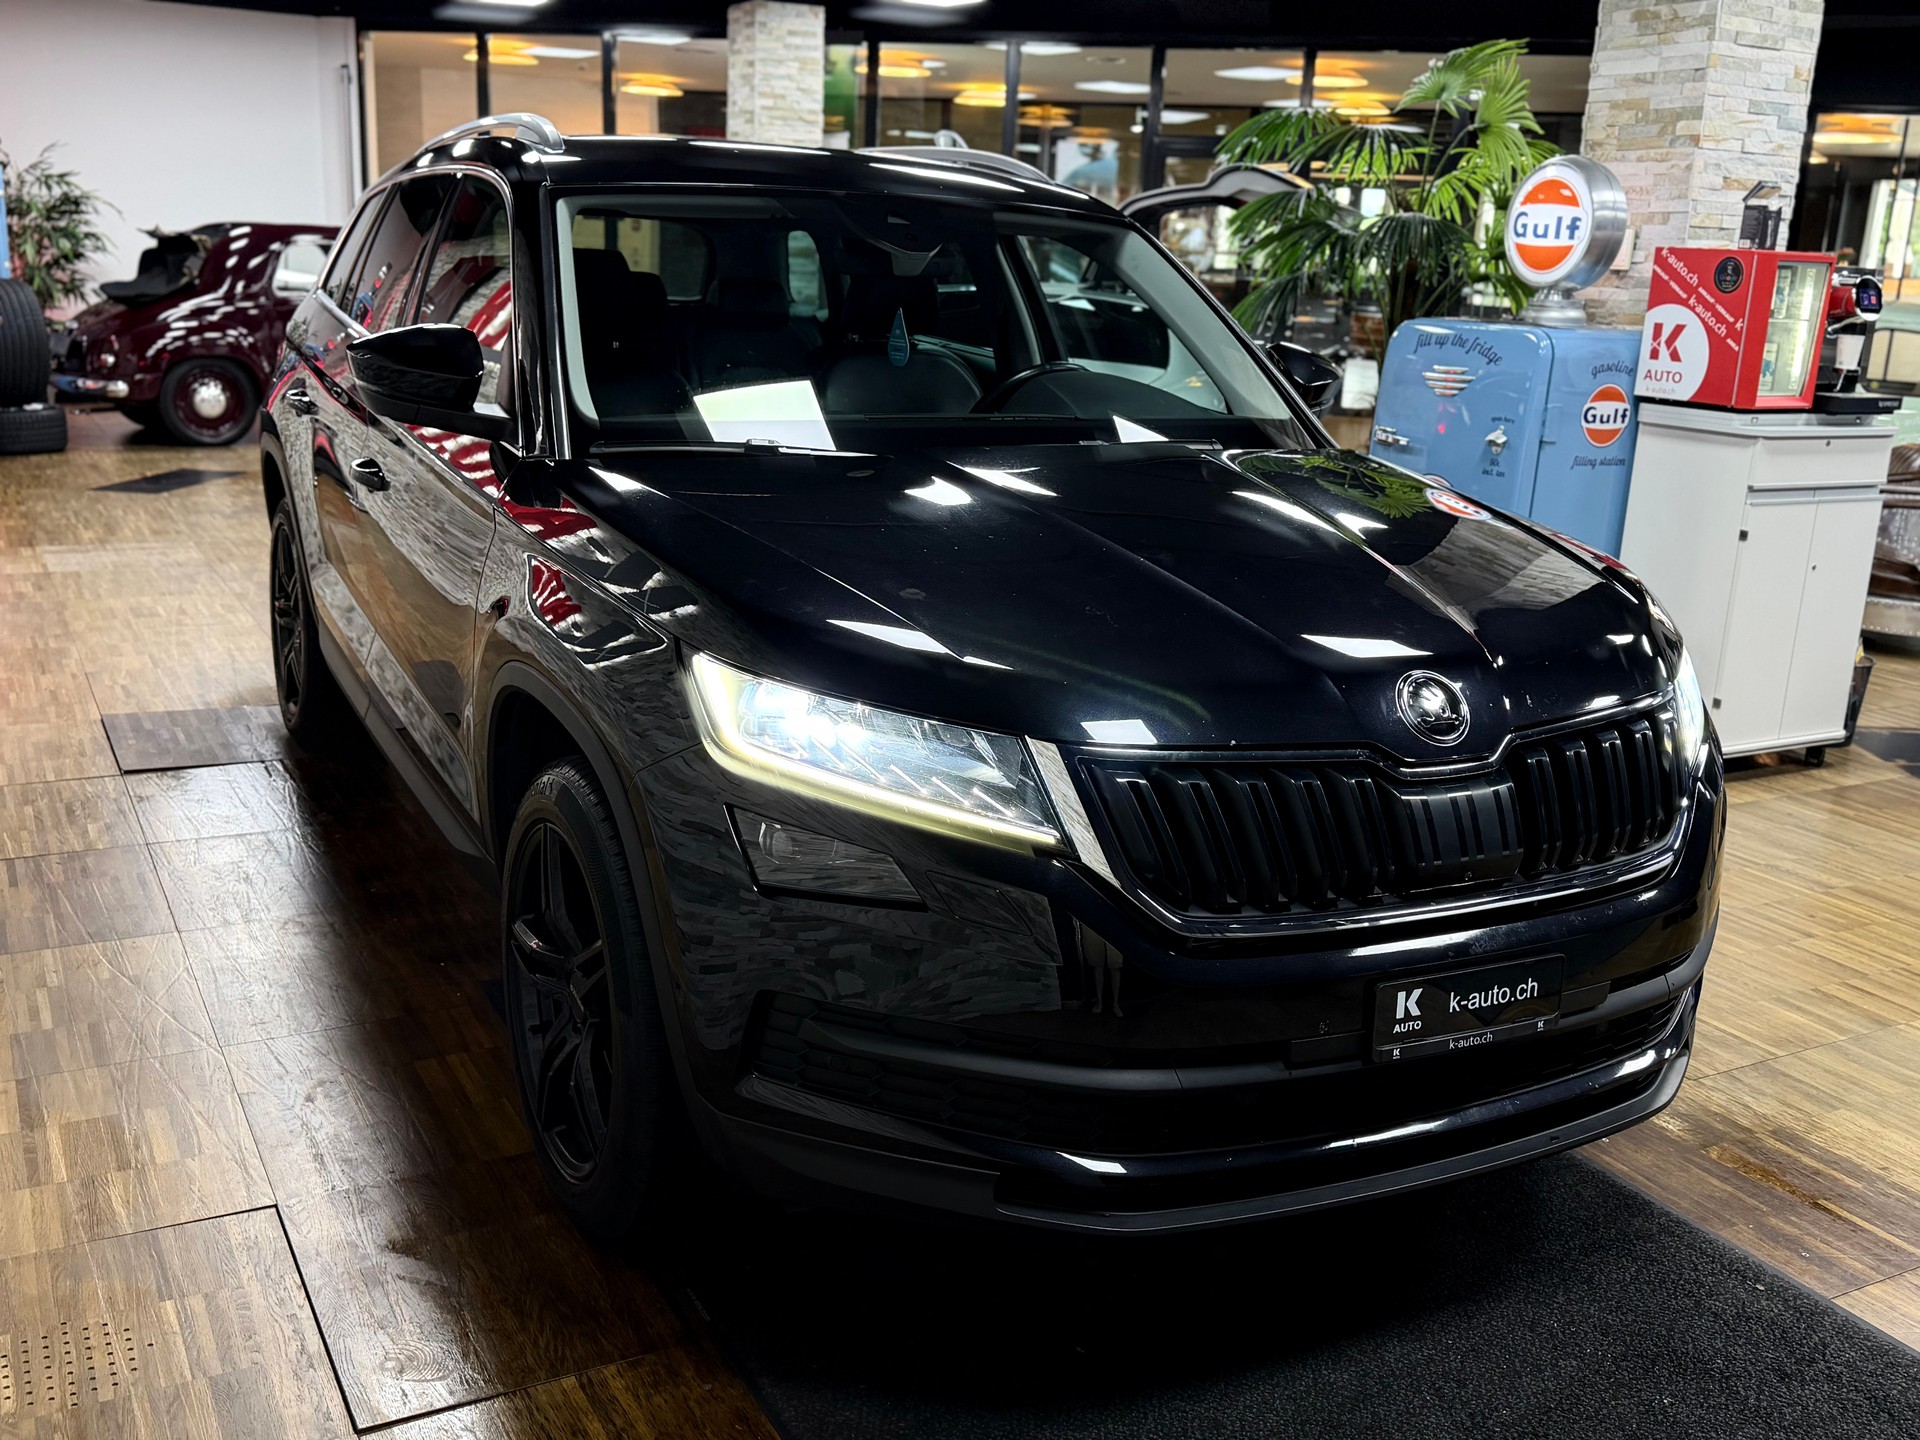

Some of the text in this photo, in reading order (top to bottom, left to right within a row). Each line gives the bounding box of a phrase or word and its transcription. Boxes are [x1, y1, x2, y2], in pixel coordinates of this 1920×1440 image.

[1513, 211, 1582, 240] Gulf
[1661, 247, 1699, 286] k-auto.ch
[1688, 294, 1727, 337] k-auto.ch
[1414, 333, 1503, 366] fill up the fridge
[1649, 322, 1688, 363] K
[1591, 360, 1634, 380] gasoline
[1643, 369, 1683, 384] AUTO
[1583, 406, 1629, 424] Gulf
[1570, 455, 1626, 470] filling station
[1396, 988, 1424, 1019] K
[1449, 977, 1538, 1013] k-auto.ch
[1393, 1020, 1422, 1034] AUTO
[1393, 1048, 1400, 1056] K
[1449, 1032, 1493, 1049] k-auto.ch
